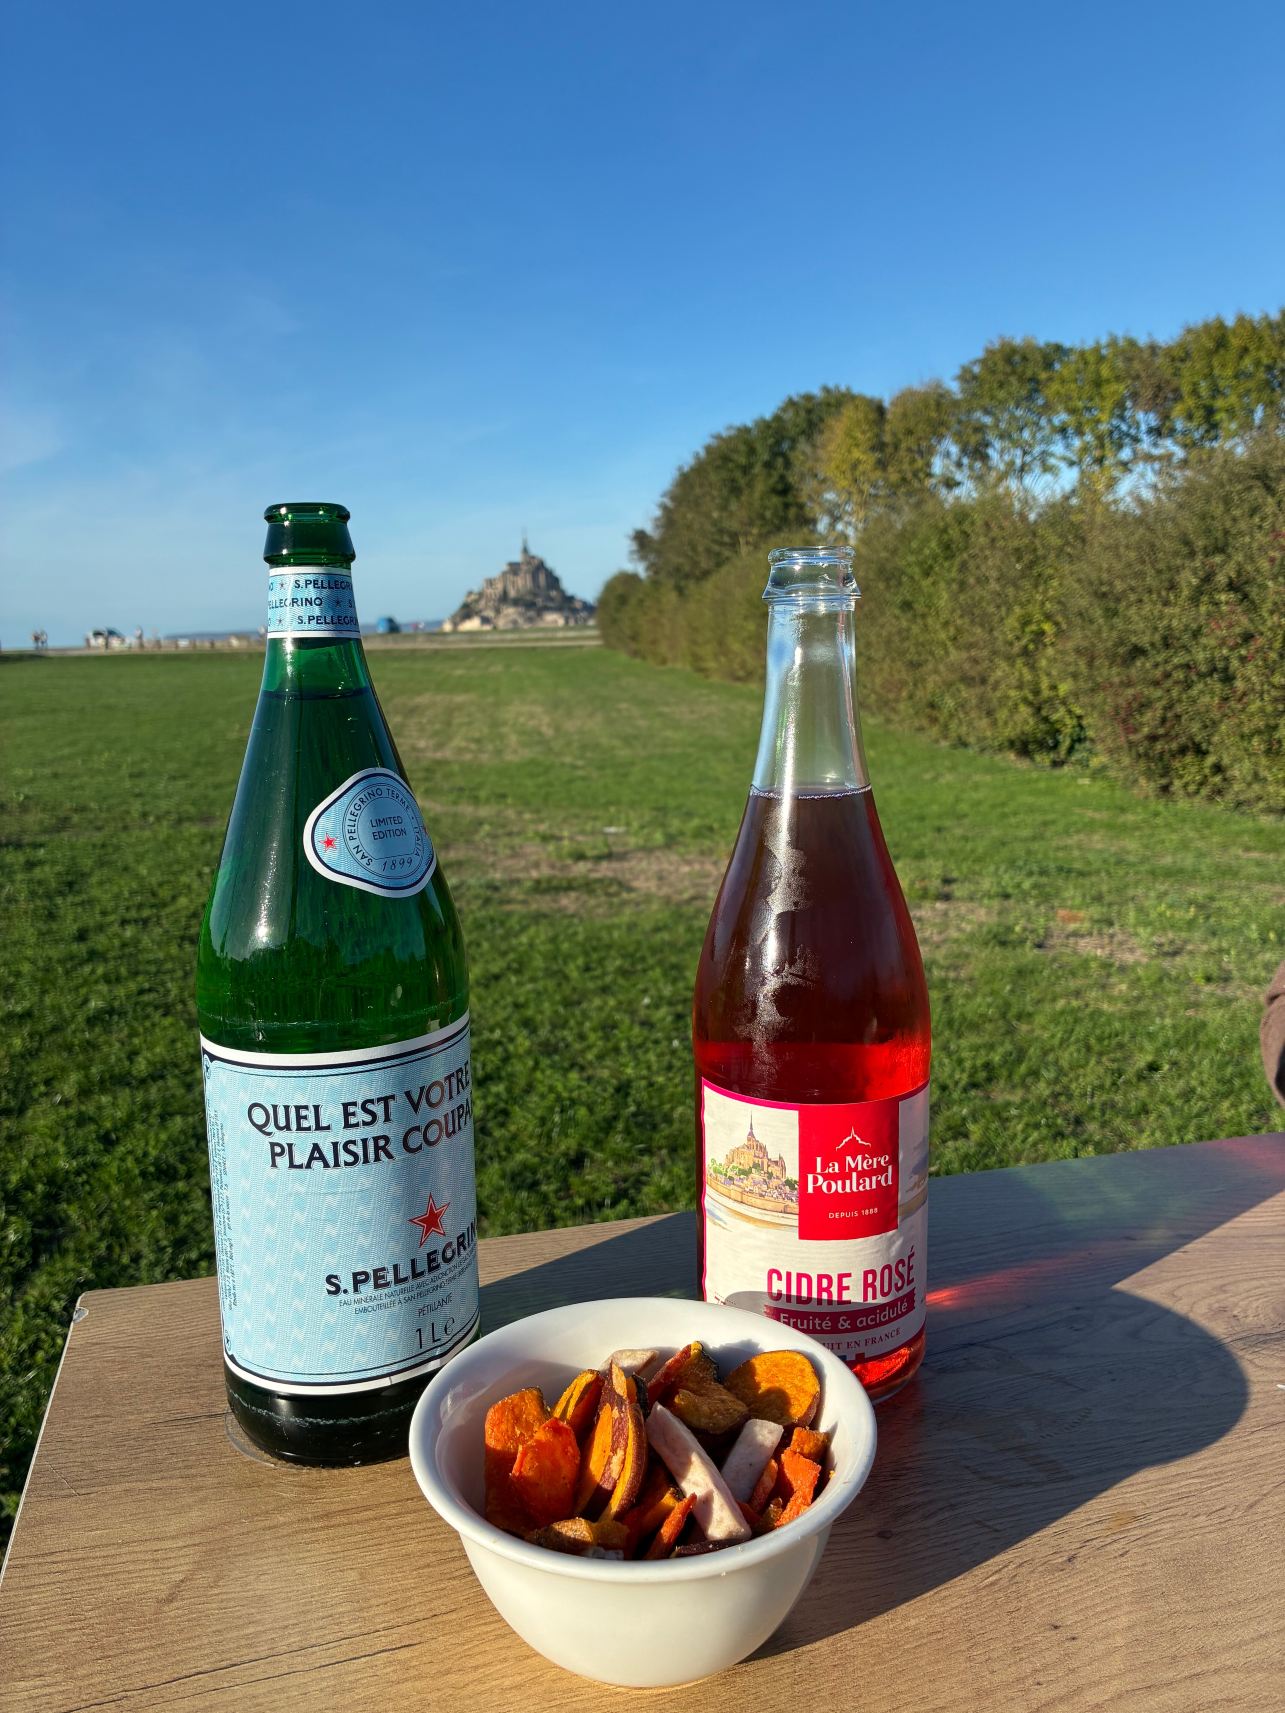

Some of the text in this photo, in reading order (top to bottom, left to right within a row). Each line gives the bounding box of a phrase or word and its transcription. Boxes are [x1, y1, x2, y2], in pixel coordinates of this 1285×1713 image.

[347, 788, 383, 842] PELLEGRINO
[371, 816, 403, 828] LIMITED
[373, 829, 407, 841] EDITION
[353, 845, 373, 866] SAN
[382, 857, 413, 872] 1899
[248, 1061, 470, 1137] QUEL EST VOTRE
[269, 1135, 396, 1170] PLAISIR
[402, 1091, 473, 1154] COUPA
[815, 1153, 890, 1174] La Mère
[807, 1165, 893, 1195] Poulard
[829, 1207, 879, 1220] DEPUIS 1888
[767, 1246, 916, 1307] CIDRE ROSÉ
[780, 1301, 909, 1331] Fruité & acidulé
[416, 1328, 424, 1350] 1
[432, 1322, 441, 1344] L
[847, 1340, 861, 1350] EN
[865, 1327, 901, 1347] FRANCE
